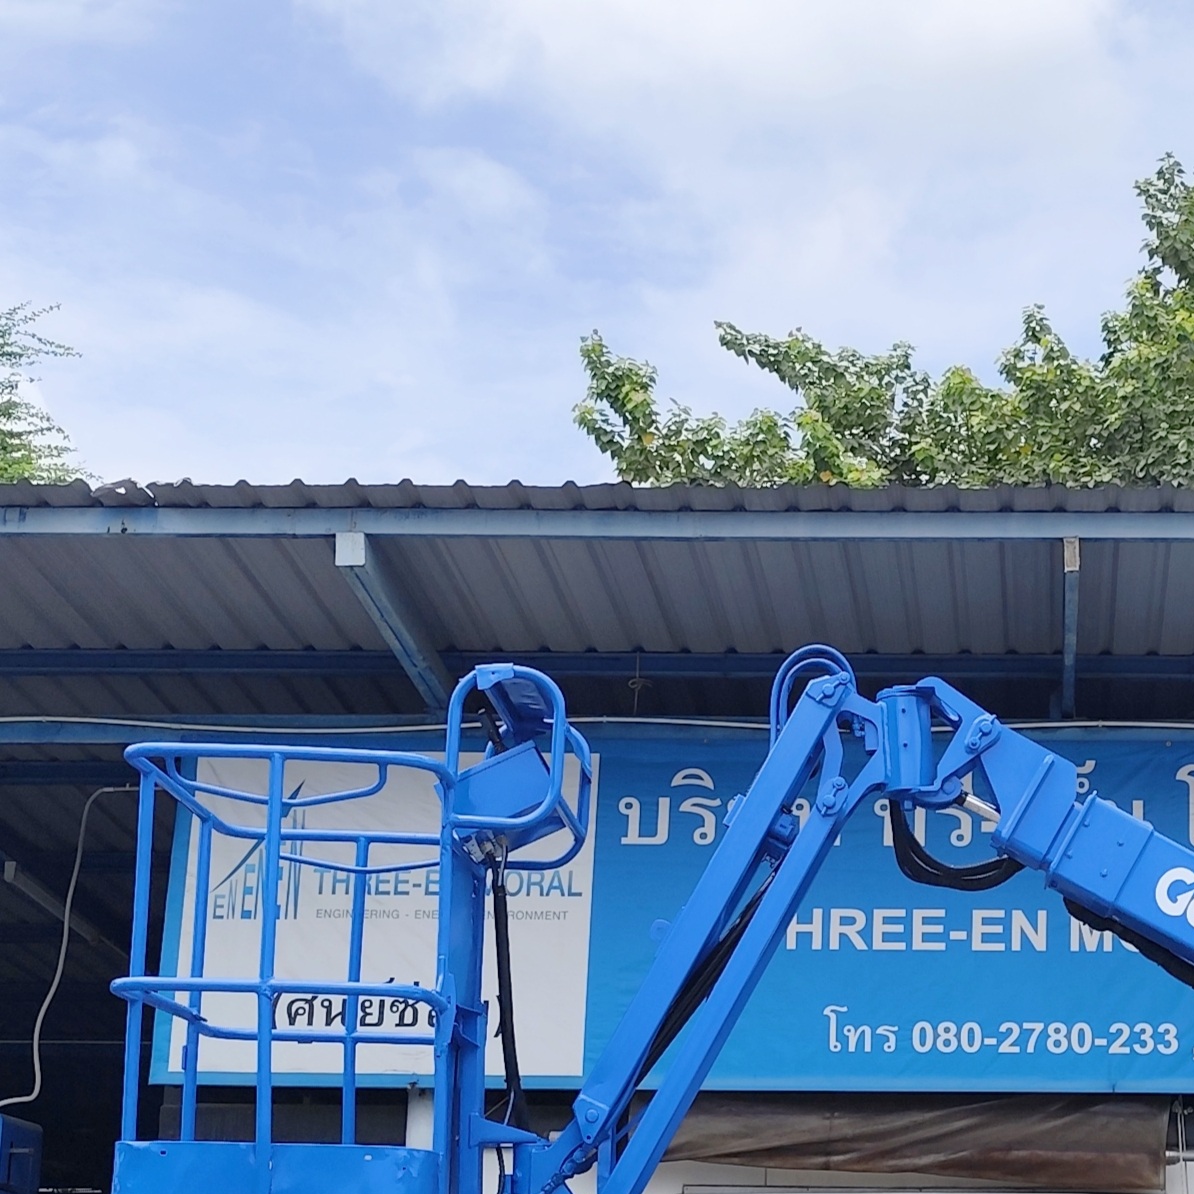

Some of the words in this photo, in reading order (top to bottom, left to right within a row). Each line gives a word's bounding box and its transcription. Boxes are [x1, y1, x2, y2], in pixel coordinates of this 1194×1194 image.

[486, 870, 583, 897] ORAL
[315, 908, 400, 920] ENGINERING
[786, 907, 1049, 953] HREE-EN
[822, 1004, 899, 1053] โทร
[911, 1021, 1179, 1055] 080-2780-233
